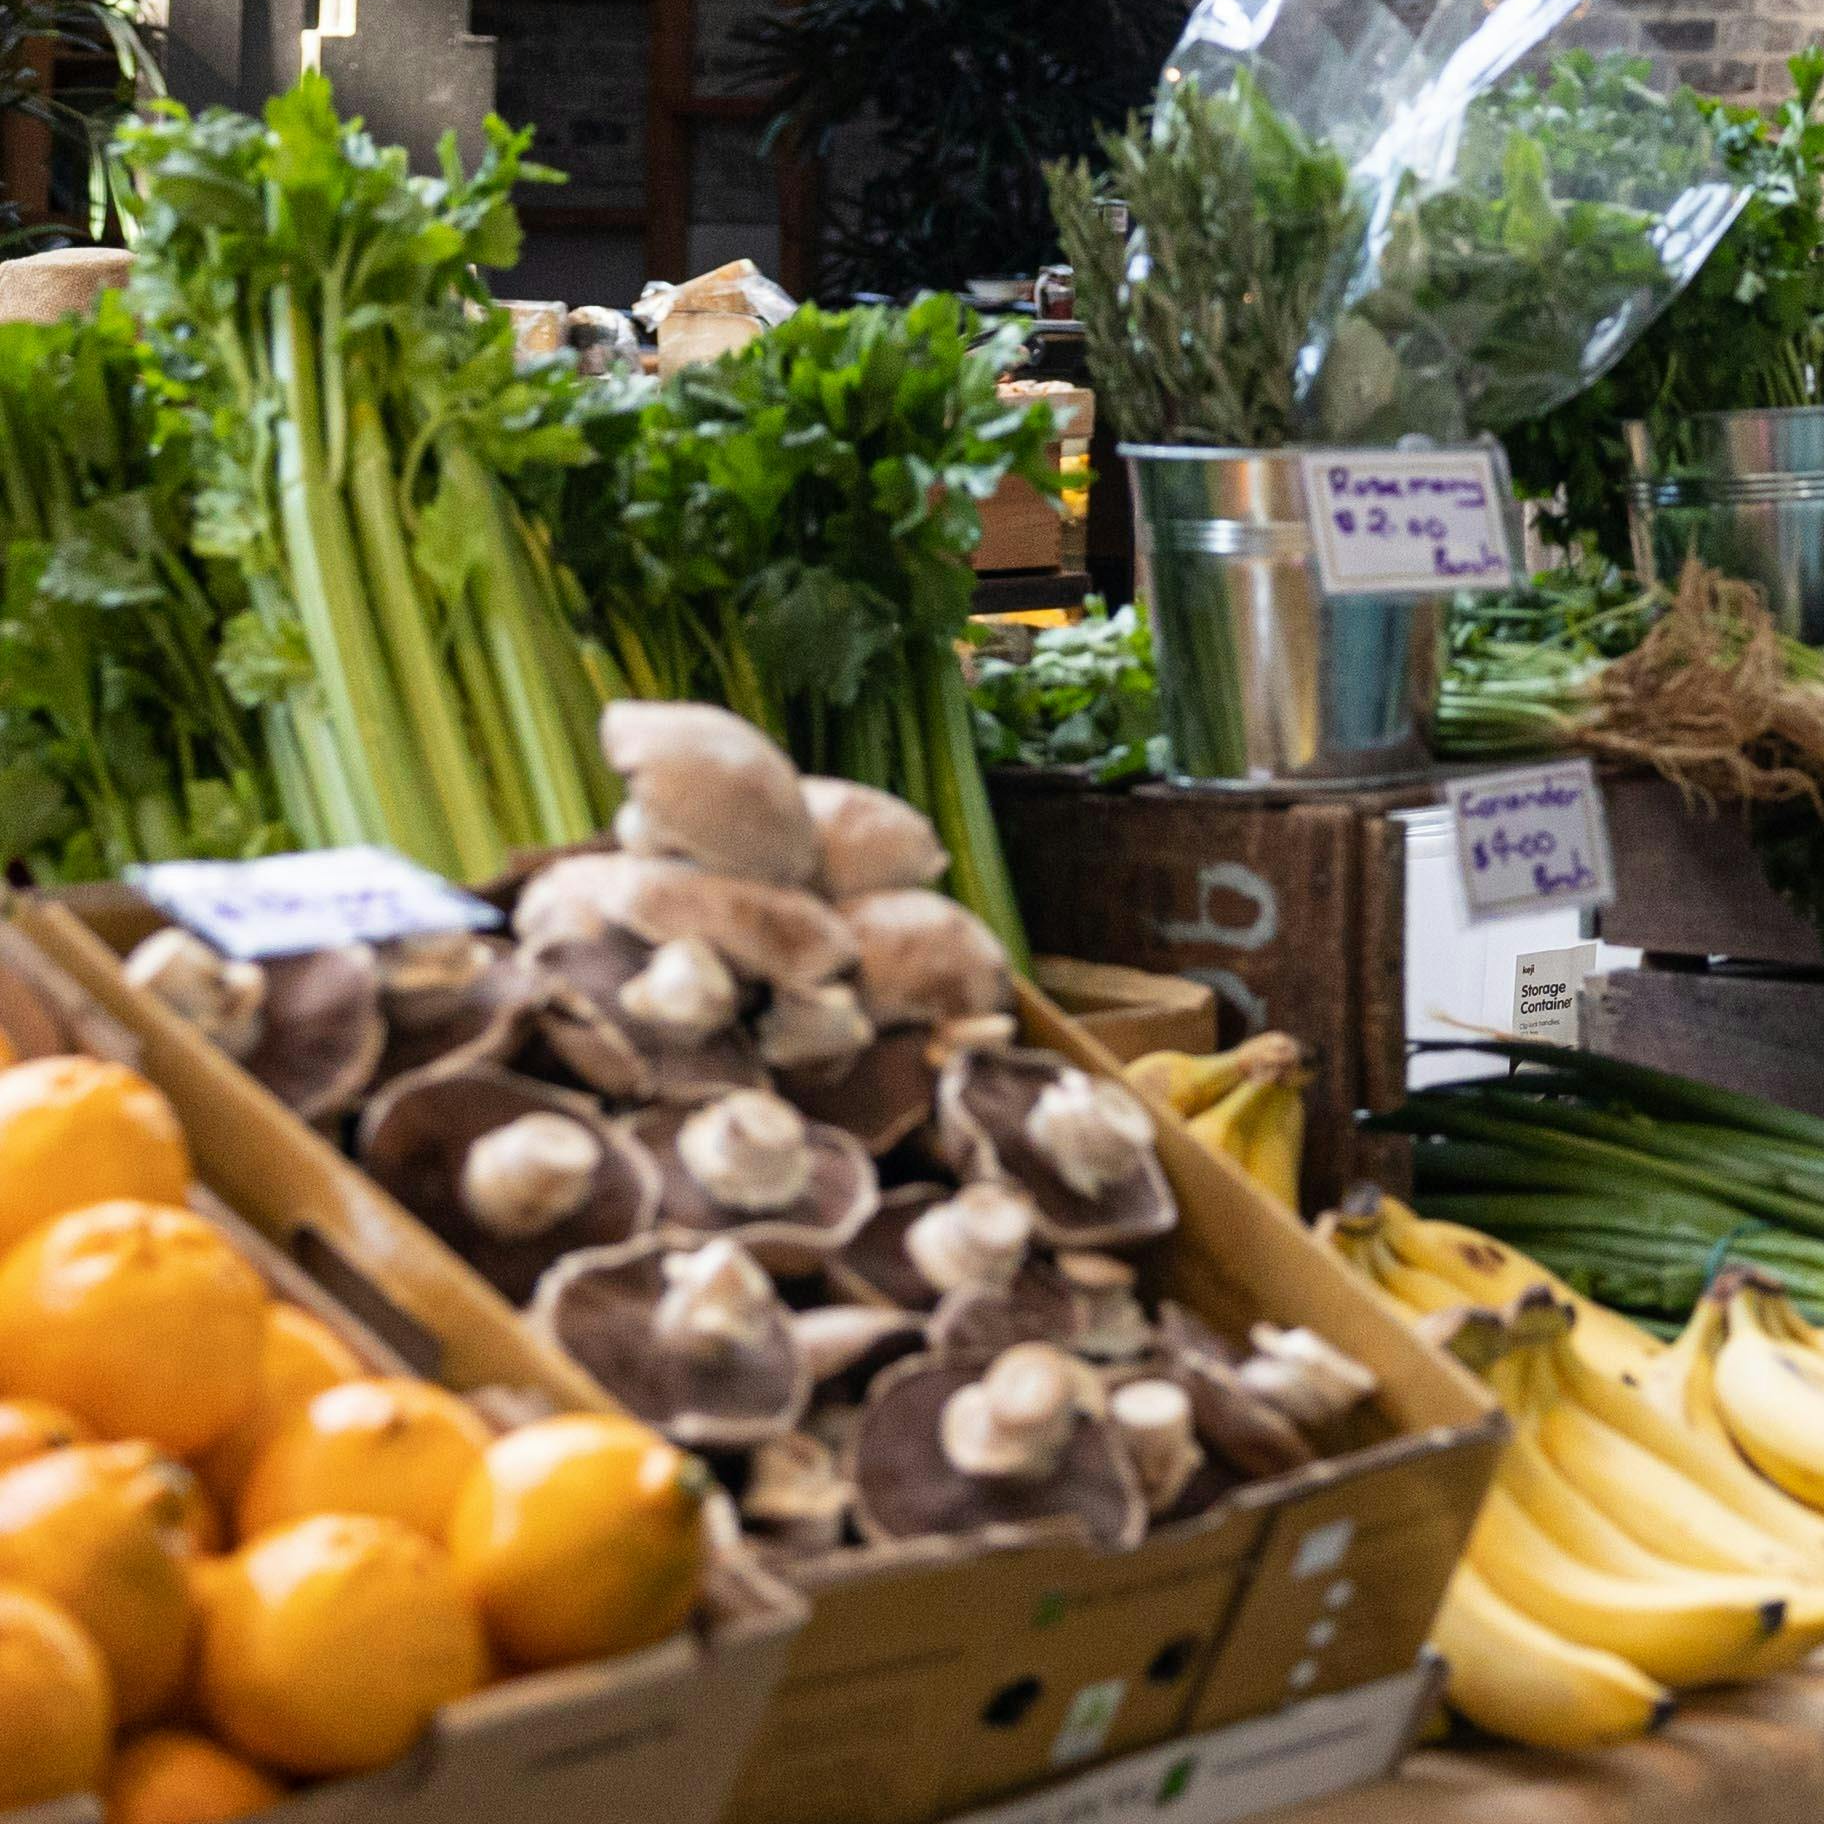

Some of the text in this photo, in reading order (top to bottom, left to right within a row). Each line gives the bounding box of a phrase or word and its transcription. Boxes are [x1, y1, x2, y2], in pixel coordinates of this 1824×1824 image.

[1522, 964, 1535, 976] keji
[1521, 982, 1567, 998] Storage
[1520, 997, 1573, 1015] Container
